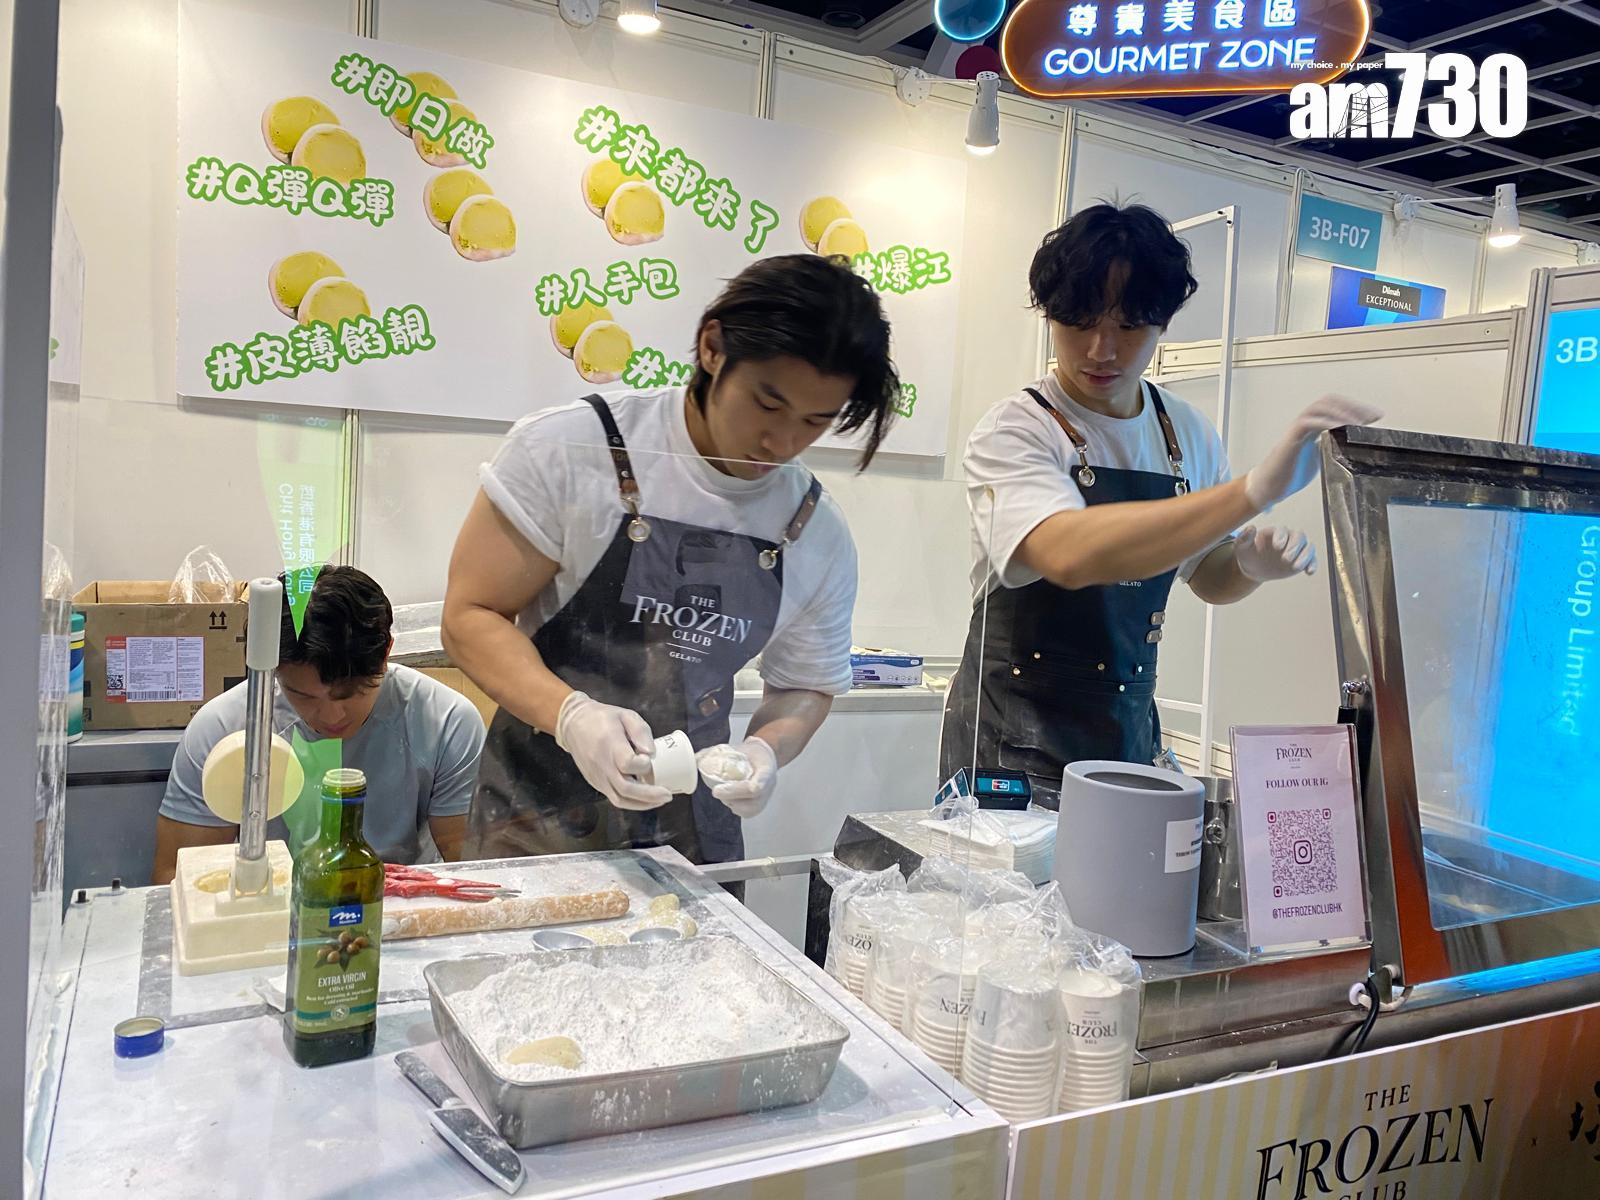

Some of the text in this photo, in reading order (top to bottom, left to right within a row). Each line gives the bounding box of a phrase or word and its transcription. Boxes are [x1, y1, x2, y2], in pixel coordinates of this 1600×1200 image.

[1044, 38, 1317, 76] GOURMET ZONE
[1309, 216, 1371, 249] 3B-F07
[1366, 295, 1412, 312] EXCEPTIONAL
[690, 595, 716, 608] THE
[629, 595, 752, 644] FROZEN
[672, 629, 712, 647] CLUB
[669, 651, 702, 663] GELATO
[1276, 747, 1312, 760] FROZEN
[1265, 777, 1329, 788] FOLLOW OUR IG
[1272, 902, 1343, 919] @THEFROZENCLUBHK
[318, 970, 367, 988] EXTRA VIRGIN
[1364, 1084, 1411, 1111] THE
[1256, 1098, 1494, 1200] FROZEN
